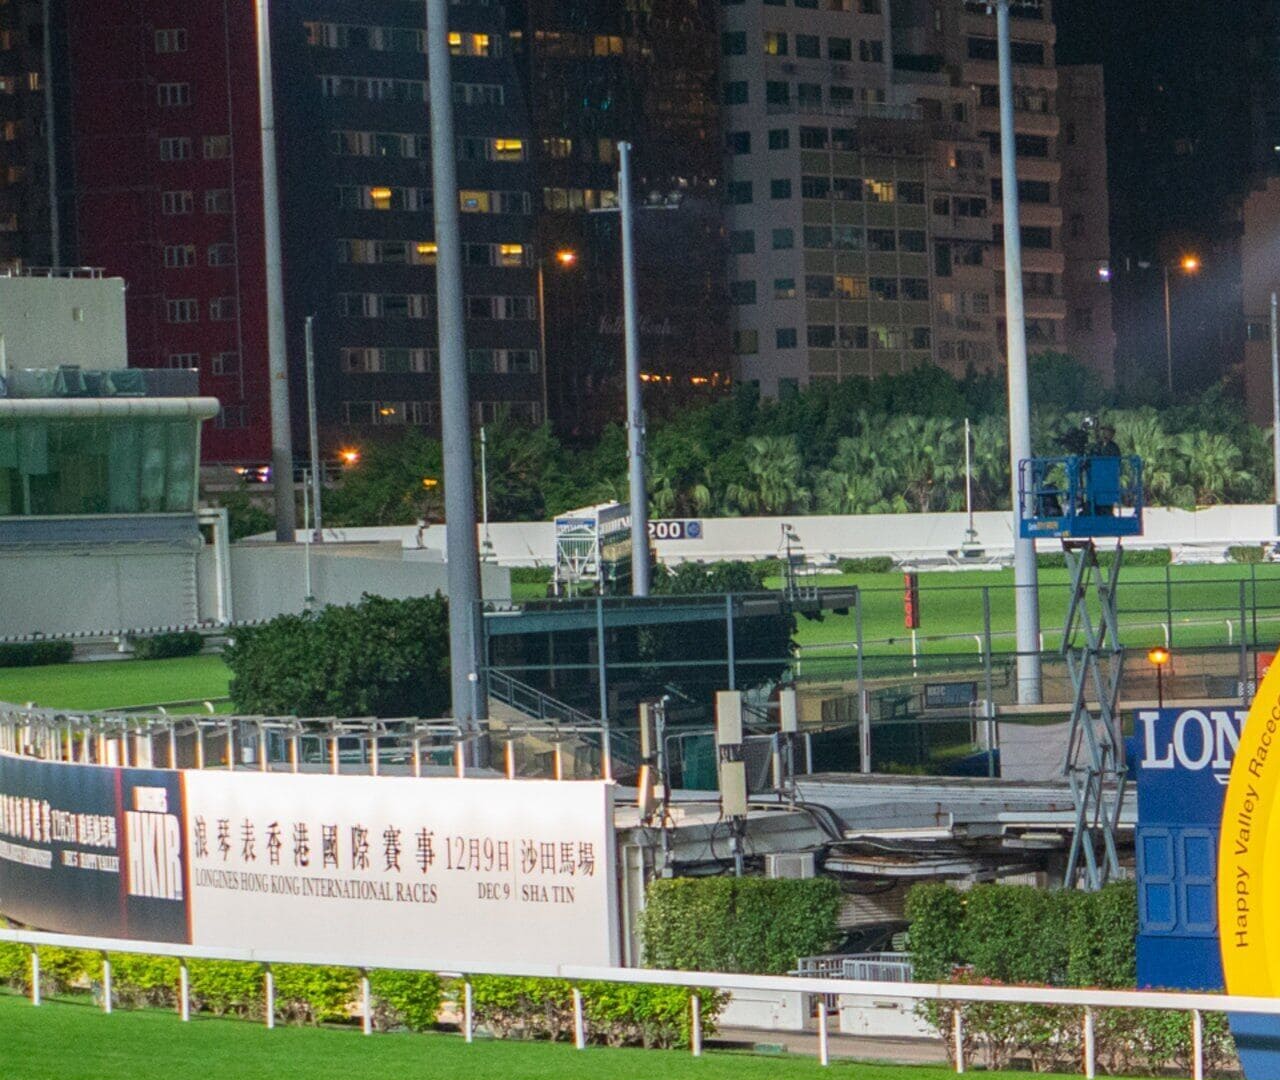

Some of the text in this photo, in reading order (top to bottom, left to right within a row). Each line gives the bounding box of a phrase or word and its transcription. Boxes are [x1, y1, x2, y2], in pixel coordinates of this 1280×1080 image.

[195, 815, 596, 877] 浪琴表香港國際賽事 12月9日 沙田馬場
[1235, 784, 1260, 855] Valley
[125, 811, 183, 900] HKIR
[195, 868, 575, 904] LONGINES HONG KONG INTERNATIONAL RACES DEC 9 SHA TIN
[1235, 866, 1250, 948] Happy
